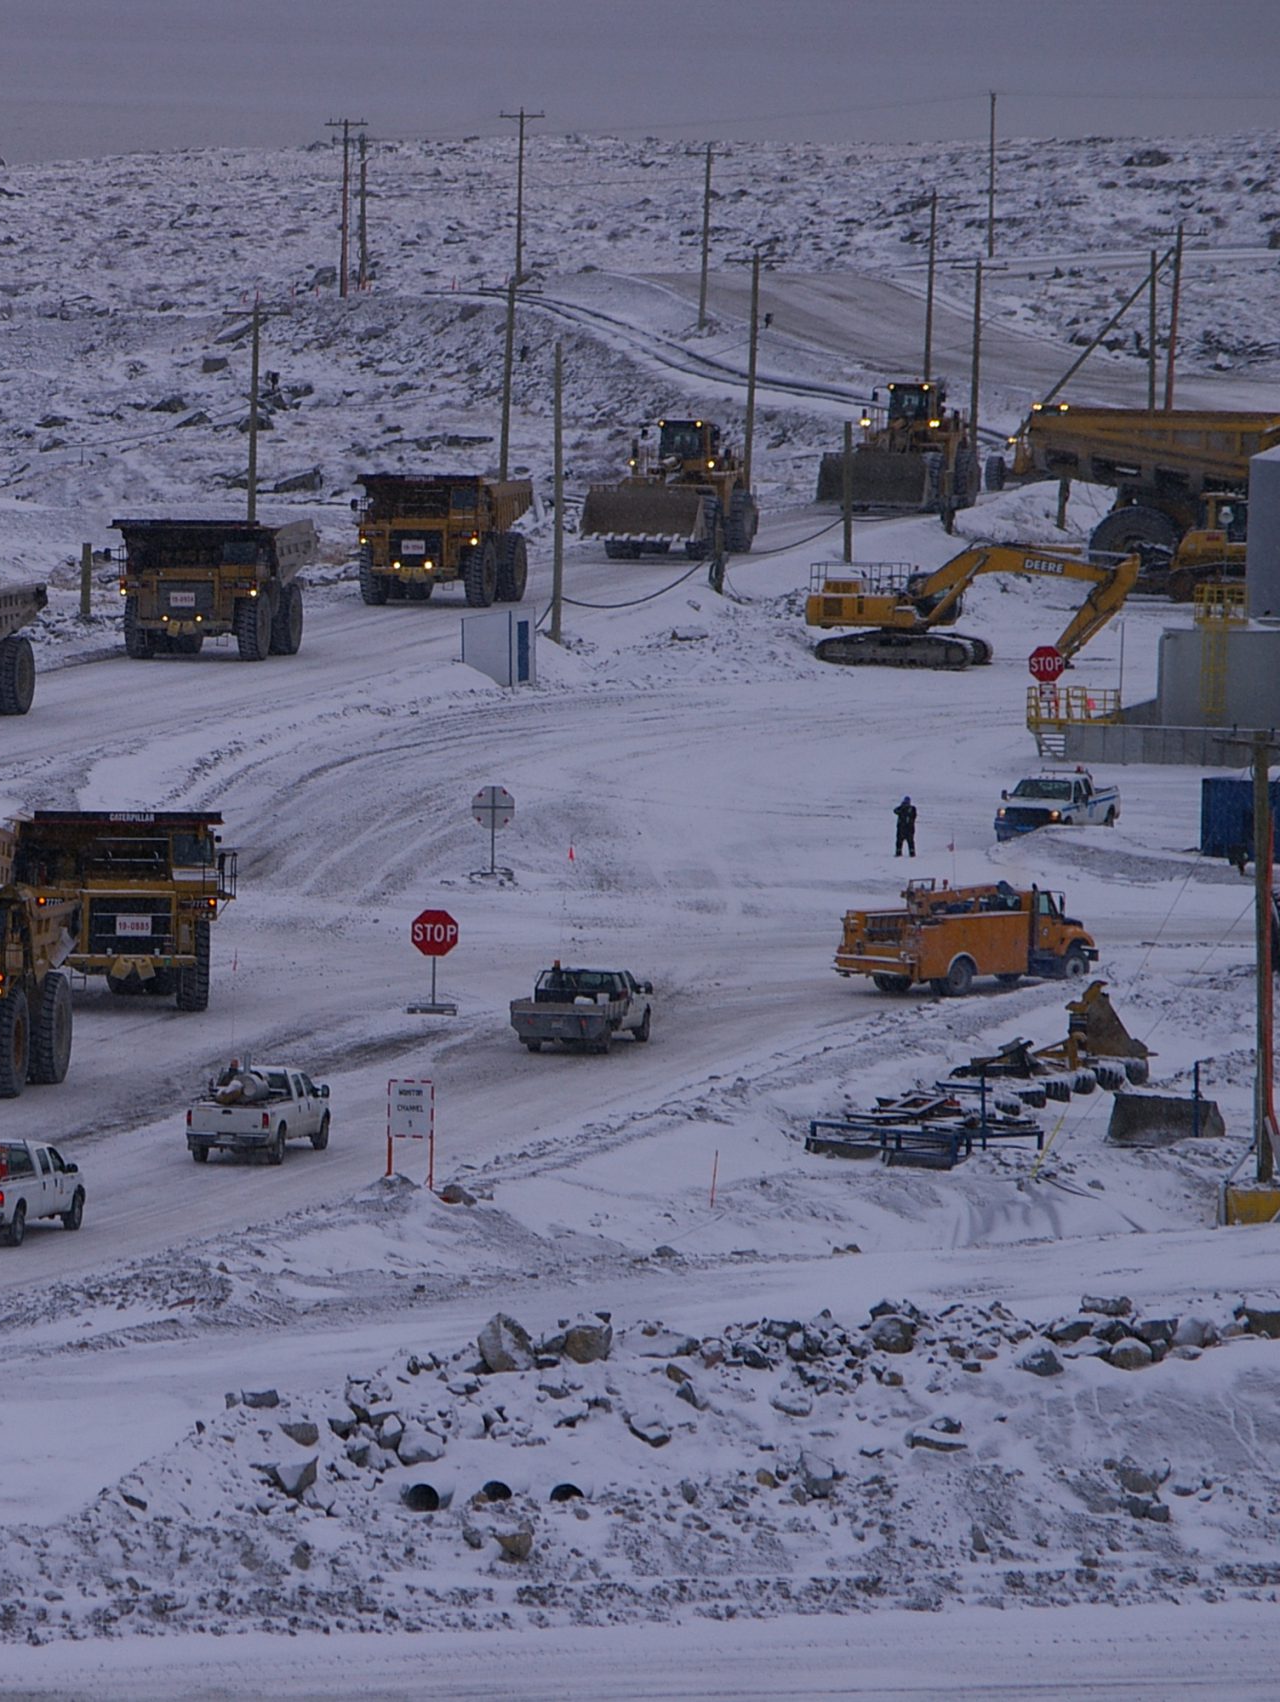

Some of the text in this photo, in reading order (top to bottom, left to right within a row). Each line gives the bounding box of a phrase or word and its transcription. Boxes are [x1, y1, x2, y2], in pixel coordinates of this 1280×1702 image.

[1024, 558, 1064, 574] DEERE
[1031, 657, 1062, 671] STOP
[109, 812, 155, 822] CATERPILLAR
[414, 923, 456, 942] STOP
[397, 1104, 424, 1112] CHANNEL
